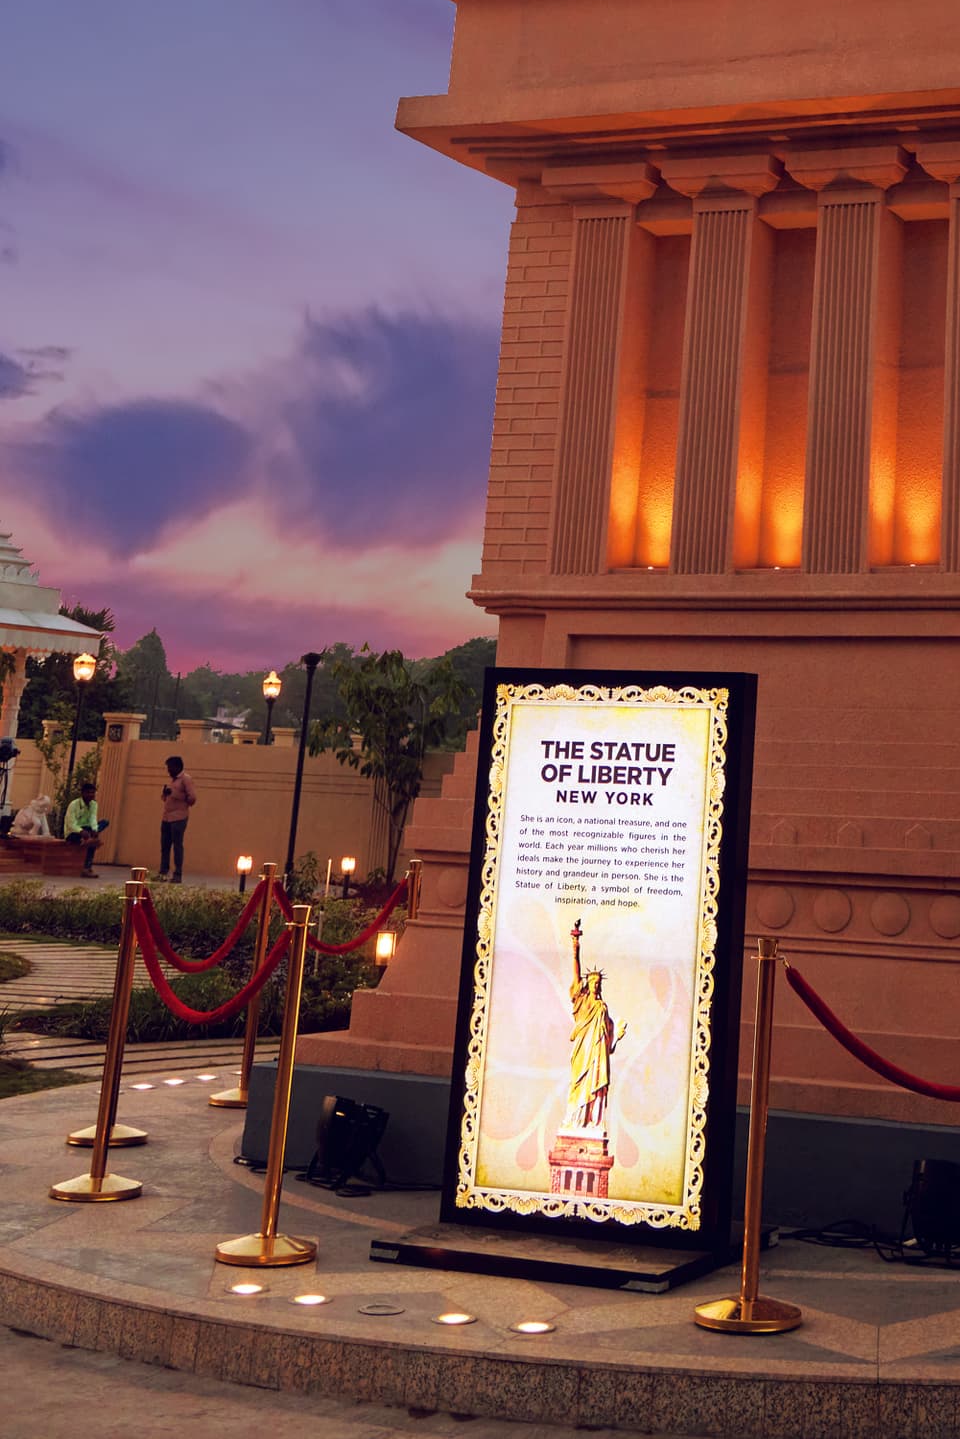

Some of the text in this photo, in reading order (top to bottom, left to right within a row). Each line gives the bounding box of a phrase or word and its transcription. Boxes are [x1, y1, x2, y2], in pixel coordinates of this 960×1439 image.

[541, 740, 676, 762] THE STATUE
[541, 764, 673, 786] OF LIBERTY
[556, 790, 654, 806] NEW YORK
[520, 814, 535, 822] She
[537, 815, 543, 823] is
[557, 816, 575, 824] icon,
[584, 817, 616, 825] national
[618, 818, 653, 827] treasure,
[654, 820, 670, 828] and
[532, 828, 545, 836] the
[573, 830, 624, 839] recognizable
[628, 832, 656, 841] figures
[661, 833, 669, 841] in
[673, 833, 686, 842] the
[518, 841, 686, 855] world. Each year millions who cherish her
[517, 854, 685, 869] ideals make the journey to experience her
[516, 867, 543, 877] history
[562, 870, 599, 878] grandeur
[611, 872, 641, 881] person.
[644, 873, 659, 881] She
[661, 874, 668, 882] is
[671, 874, 684, 882] the
[515, 880, 541, 889] Statue
[557, 882, 587, 892] Liberty,
[601, 885, 630, 893] symbol
[634, 886, 643, 894] of
[647, 886, 683, 897] freedom,
[554, 896, 640, 908] inspiration, and hope.
